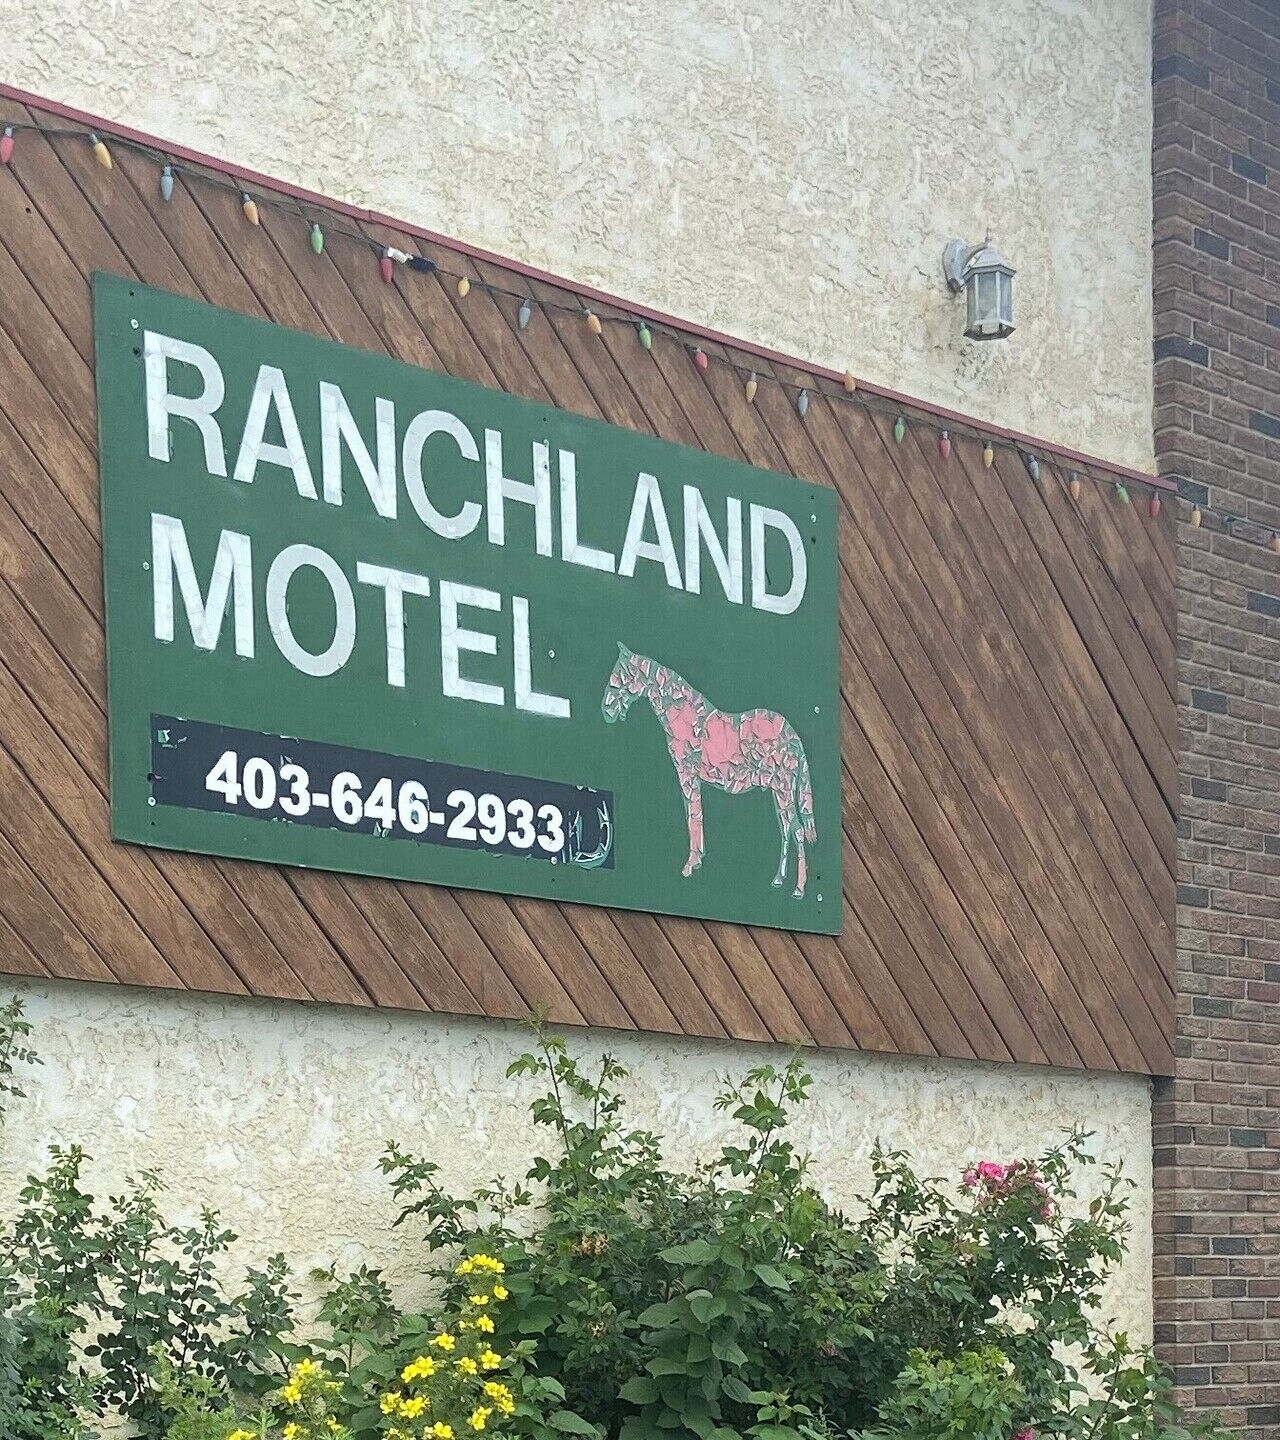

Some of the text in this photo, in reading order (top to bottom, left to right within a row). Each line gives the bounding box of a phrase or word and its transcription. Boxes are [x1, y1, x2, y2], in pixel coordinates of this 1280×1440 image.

[142, 328, 808, 616] RANCHLAND
[150, 511, 572, 719] MOTEL
[205, 749, 566, 854] 403-646-2933
